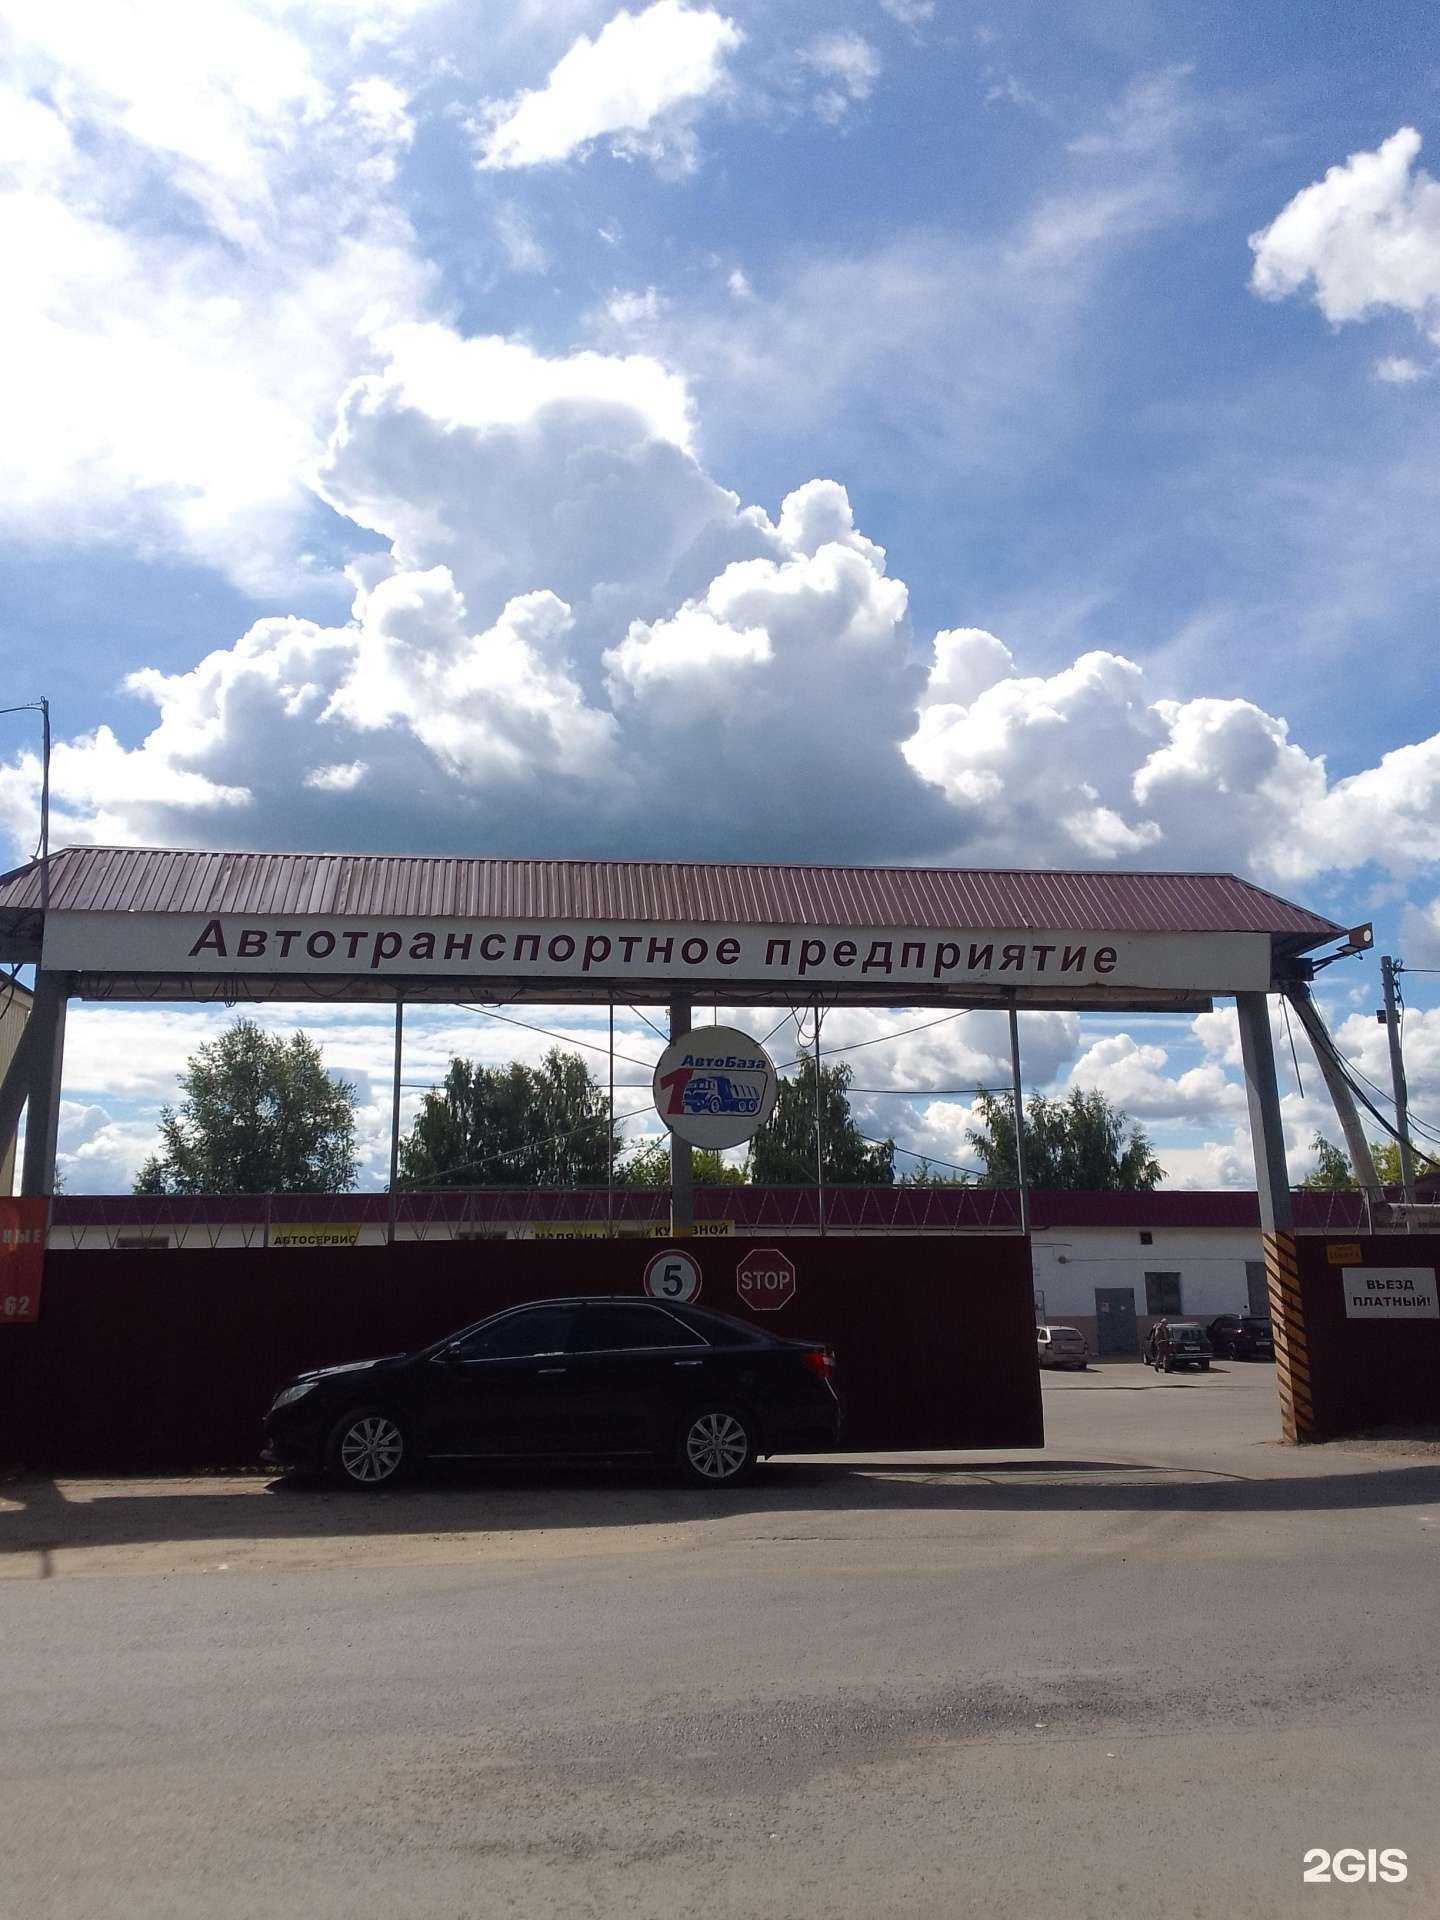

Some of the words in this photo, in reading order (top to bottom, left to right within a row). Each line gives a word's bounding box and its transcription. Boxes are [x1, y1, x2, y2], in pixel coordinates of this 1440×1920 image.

[188, 919, 742, 972] Автотранспортное
[764, 937, 1119, 977] предприятие
[681, 1054, 767, 1069] АвтоБаза
[274, 1235, 357, 1245] АВТОСЕРВИС
[662, 1264, 684, 1297] 5
[740, 1271, 791, 1290] STOP
[1352, 1295, 1432, 1307] ПЛАТНЫЙ!
